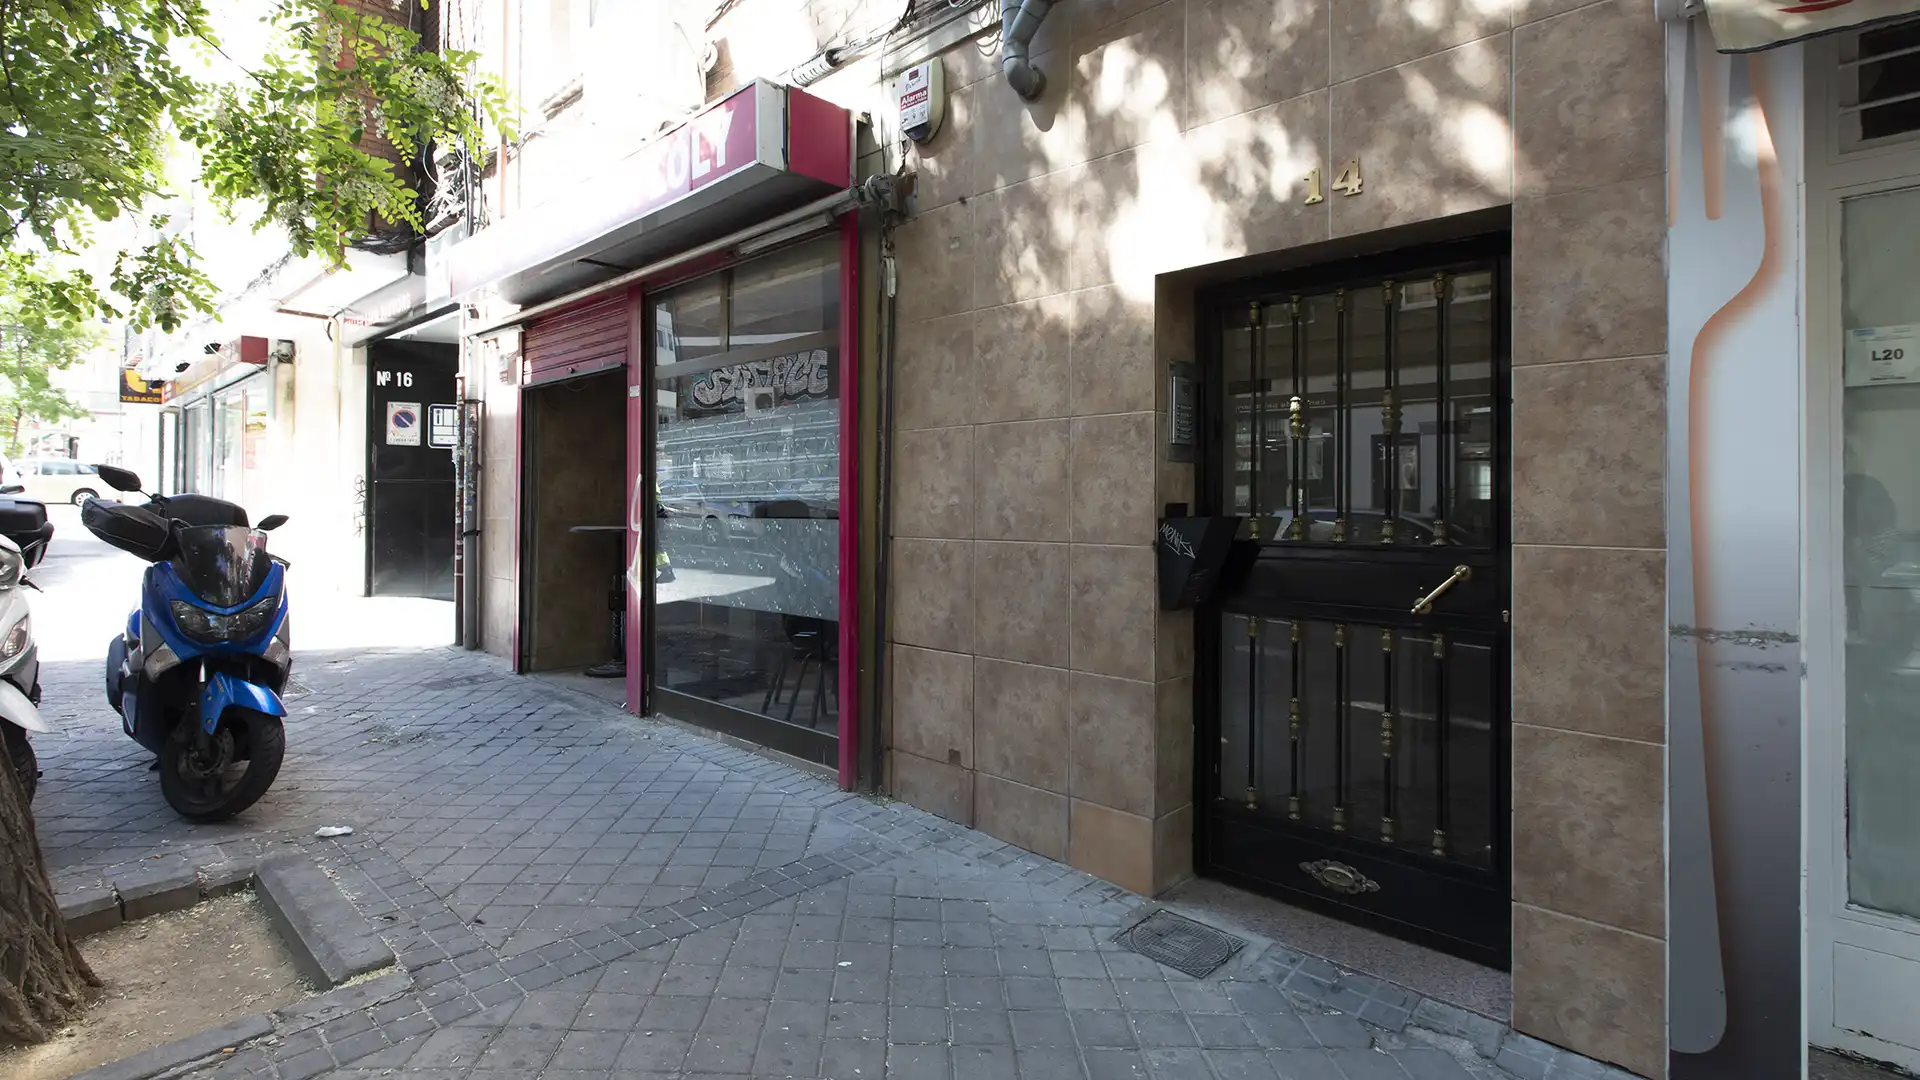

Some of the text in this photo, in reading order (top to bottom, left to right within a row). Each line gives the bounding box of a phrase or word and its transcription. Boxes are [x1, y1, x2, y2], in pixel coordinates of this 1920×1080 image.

[901, 90, 927, 107] Alarma
[1304, 157, 1363, 205] 14
[1871, 348, 1904, 362] L20
[396, 371, 413, 387] 16
[121, 395, 162, 403] TABACO
